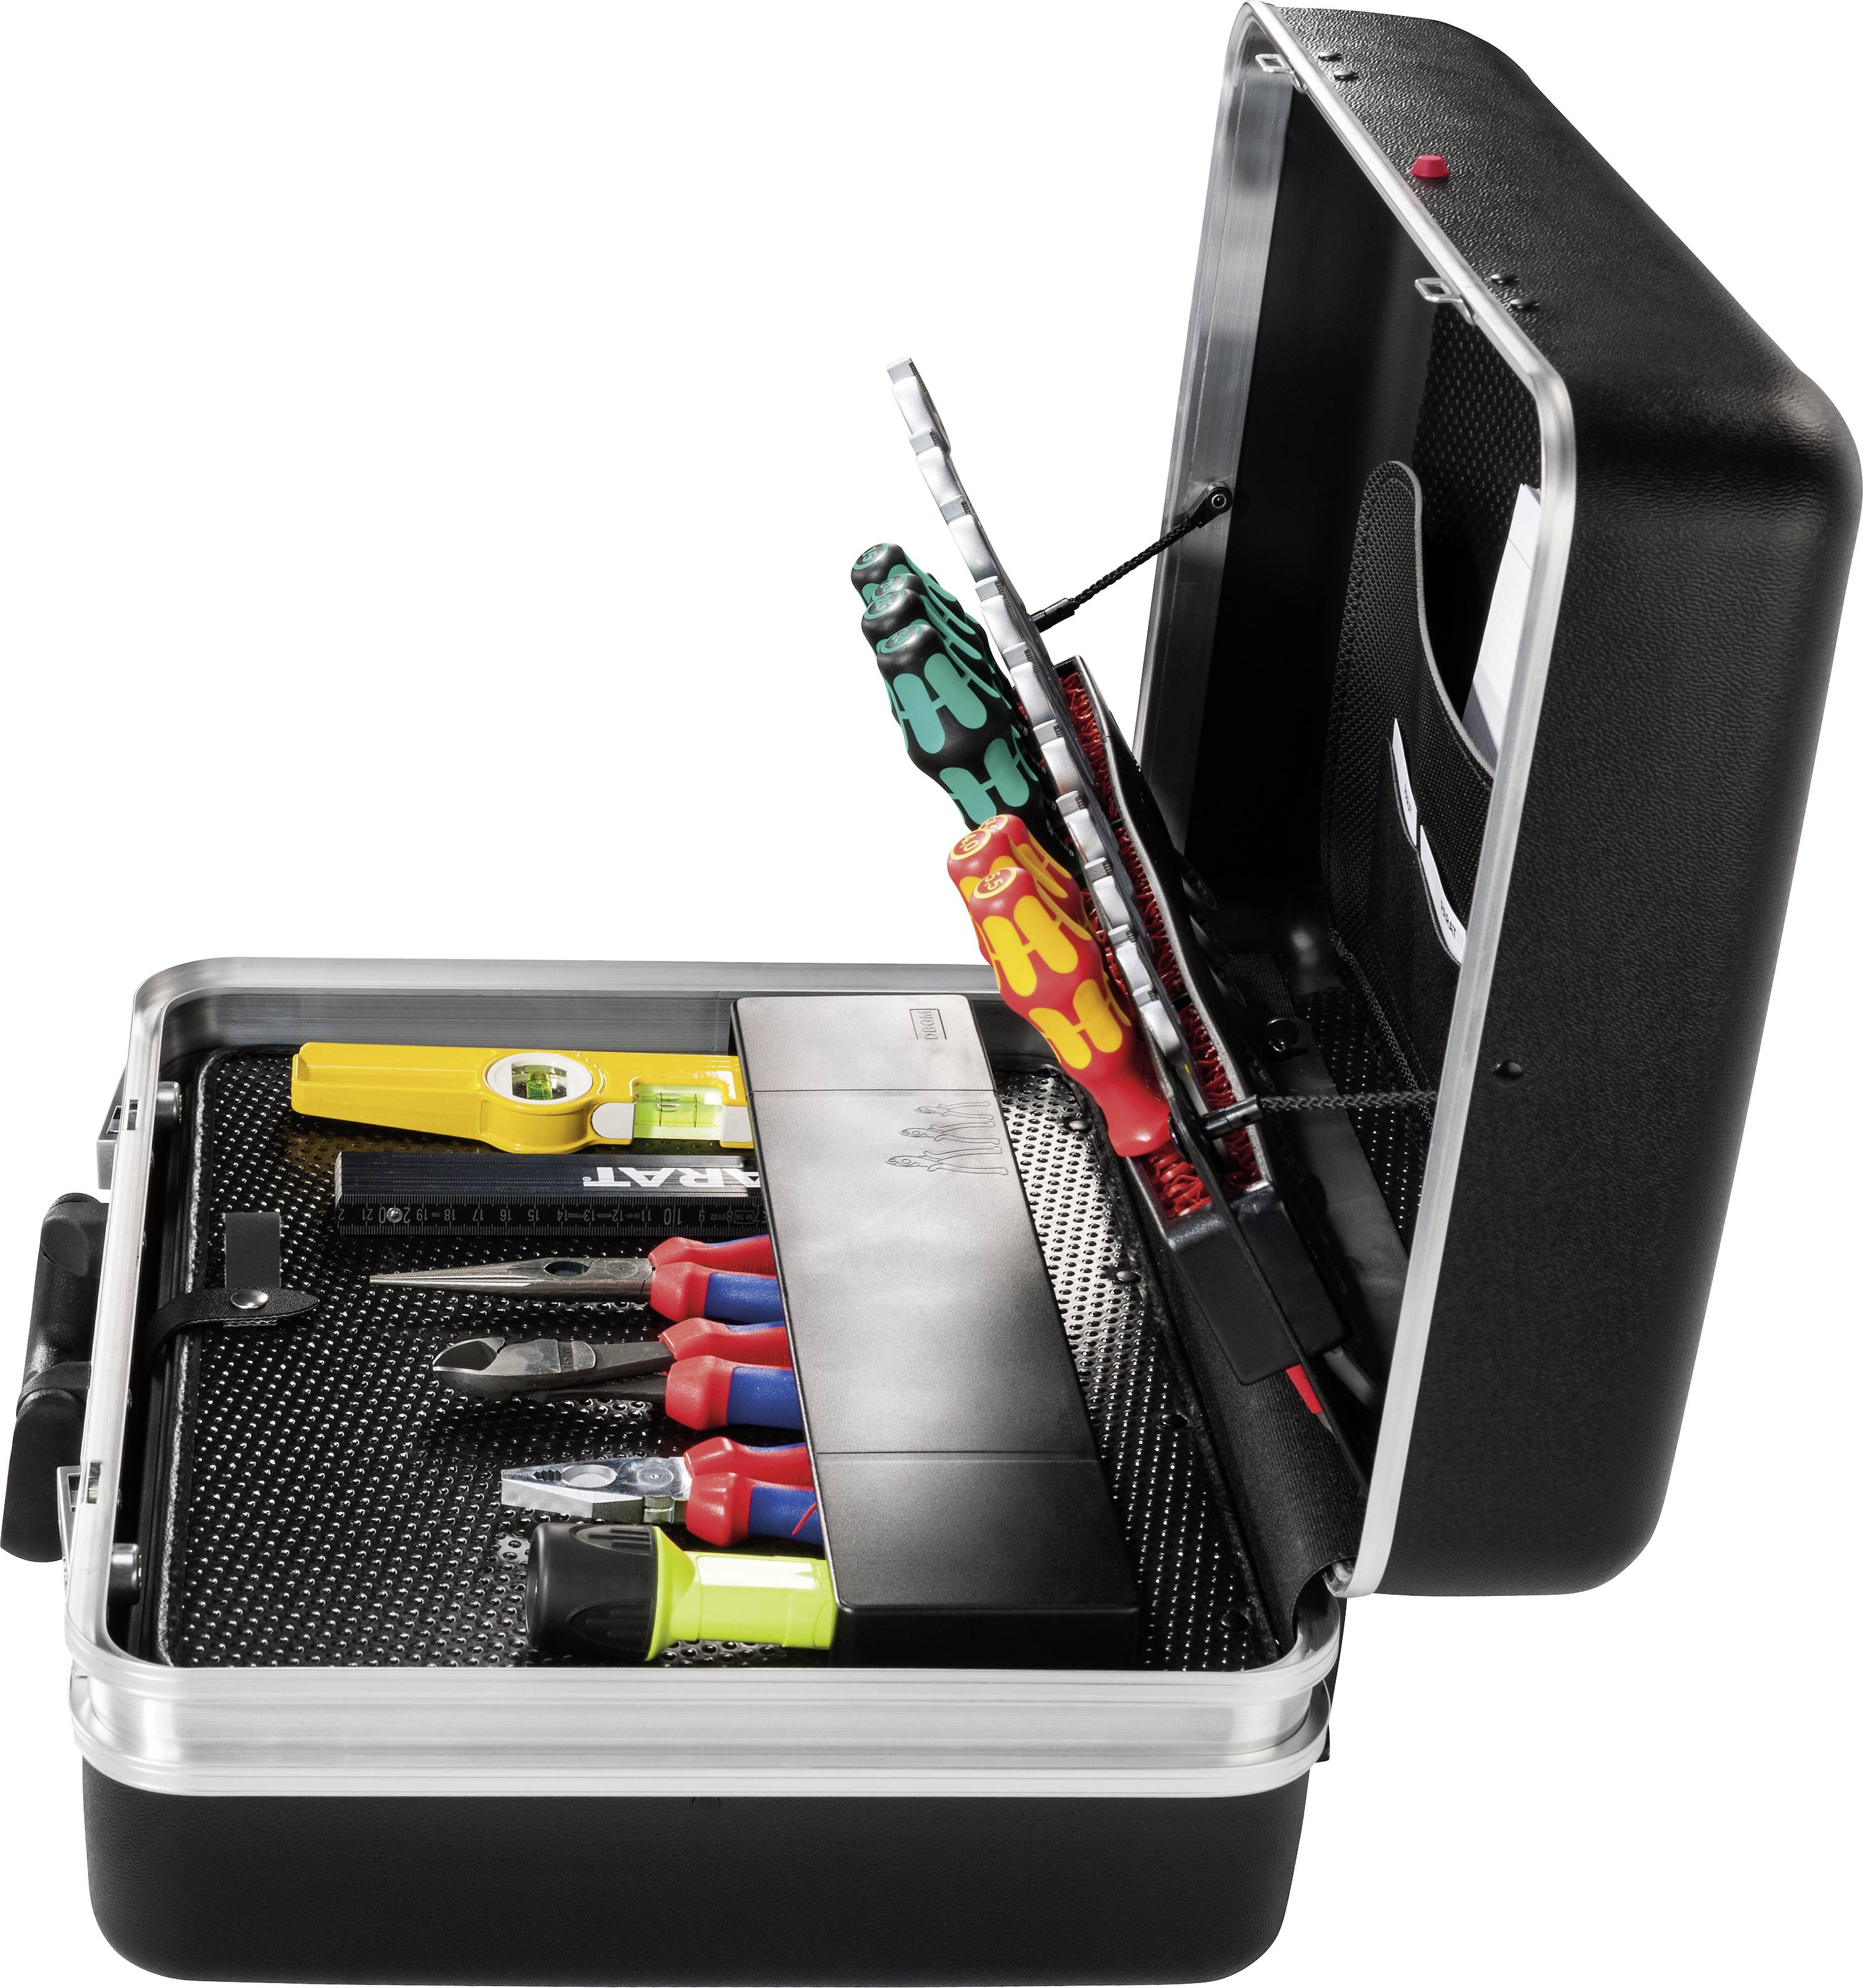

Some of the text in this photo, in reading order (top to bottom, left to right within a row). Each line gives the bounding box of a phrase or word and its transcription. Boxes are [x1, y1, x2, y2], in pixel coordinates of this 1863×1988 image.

[583, 1167, 761, 1188] ARAT
[362, 1209, 373, 1221] 21
[416, 1209, 428, 1221] 19
[444, 1209, 456, 1221] 18
[472, 1209, 484, 1222] 17
[500, 1209, 512, 1222] 16
[528, 1209, 540, 1222] 15
[557, 1209, 568, 1222] 14
[584, 1209, 595, 1222] 13
[612, 1209, 624, 1222] 12
[641, 1209, 652, 1222] 11
[664, 1208, 683, 1225] 10
[699, 1210, 706, 1222] 9
